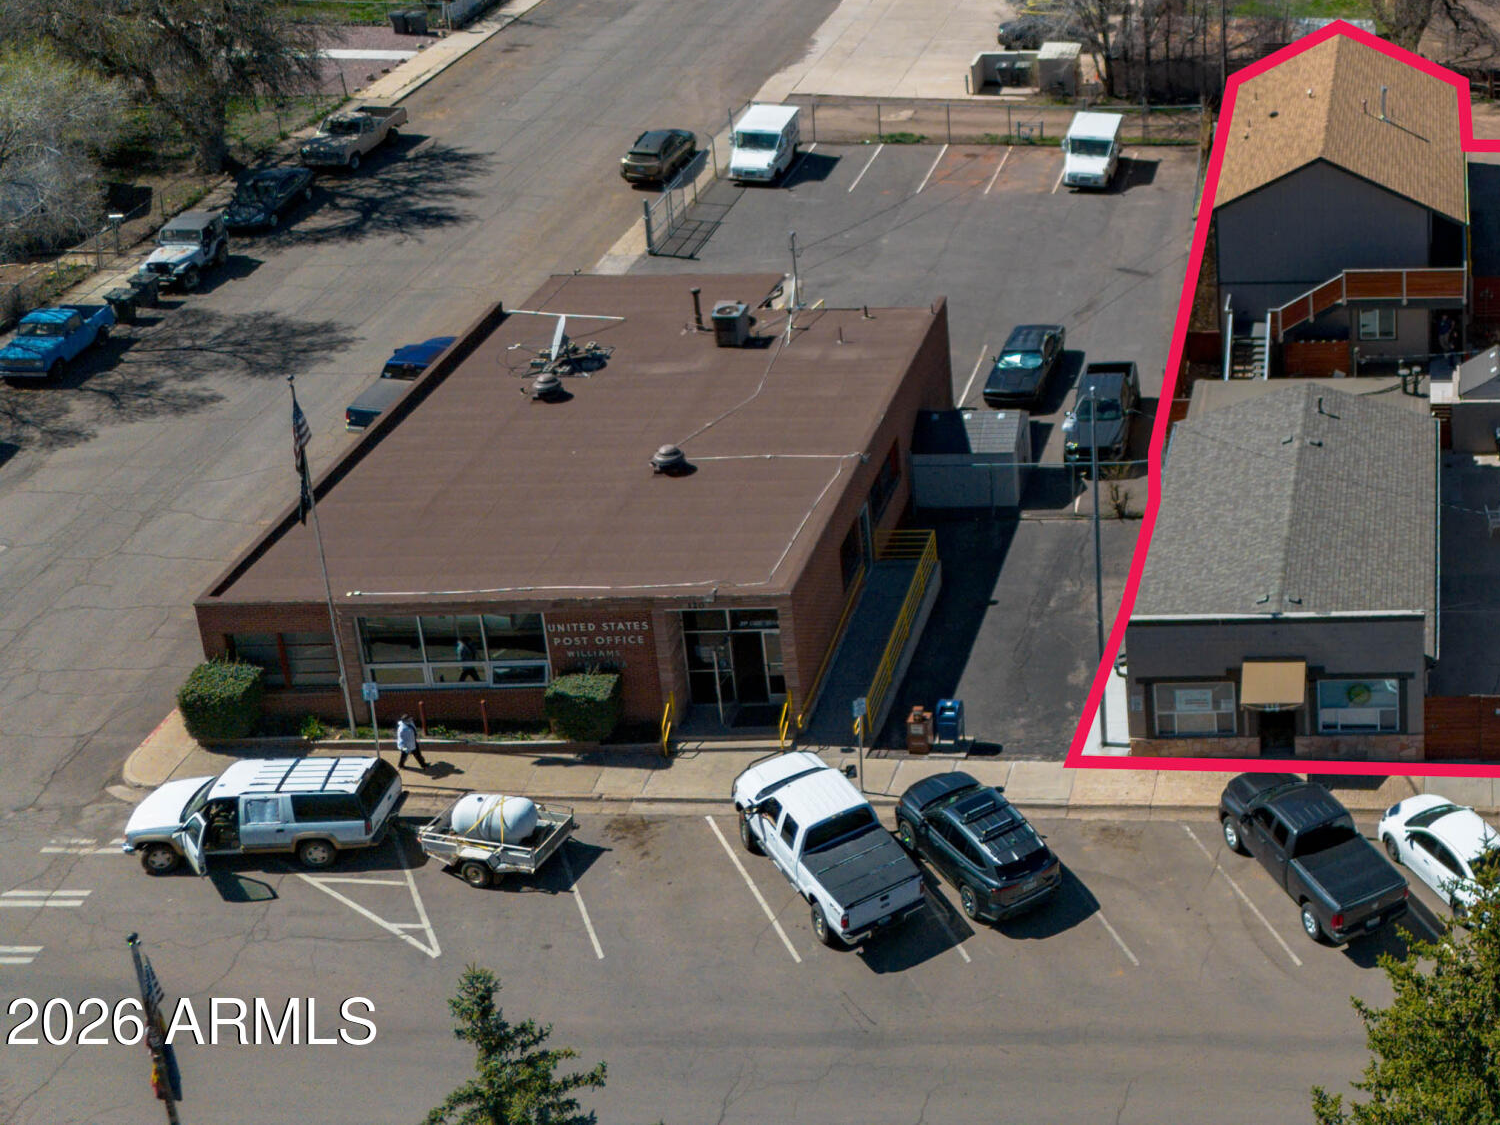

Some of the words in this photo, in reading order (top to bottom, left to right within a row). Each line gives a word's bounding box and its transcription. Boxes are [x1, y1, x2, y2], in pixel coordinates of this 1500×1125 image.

[547, 622, 596, 633] UNITED
[601, 621, 649, 632] STATES
[553, 636, 589, 646] POST
[594, 635, 645, 645] OFFICE
